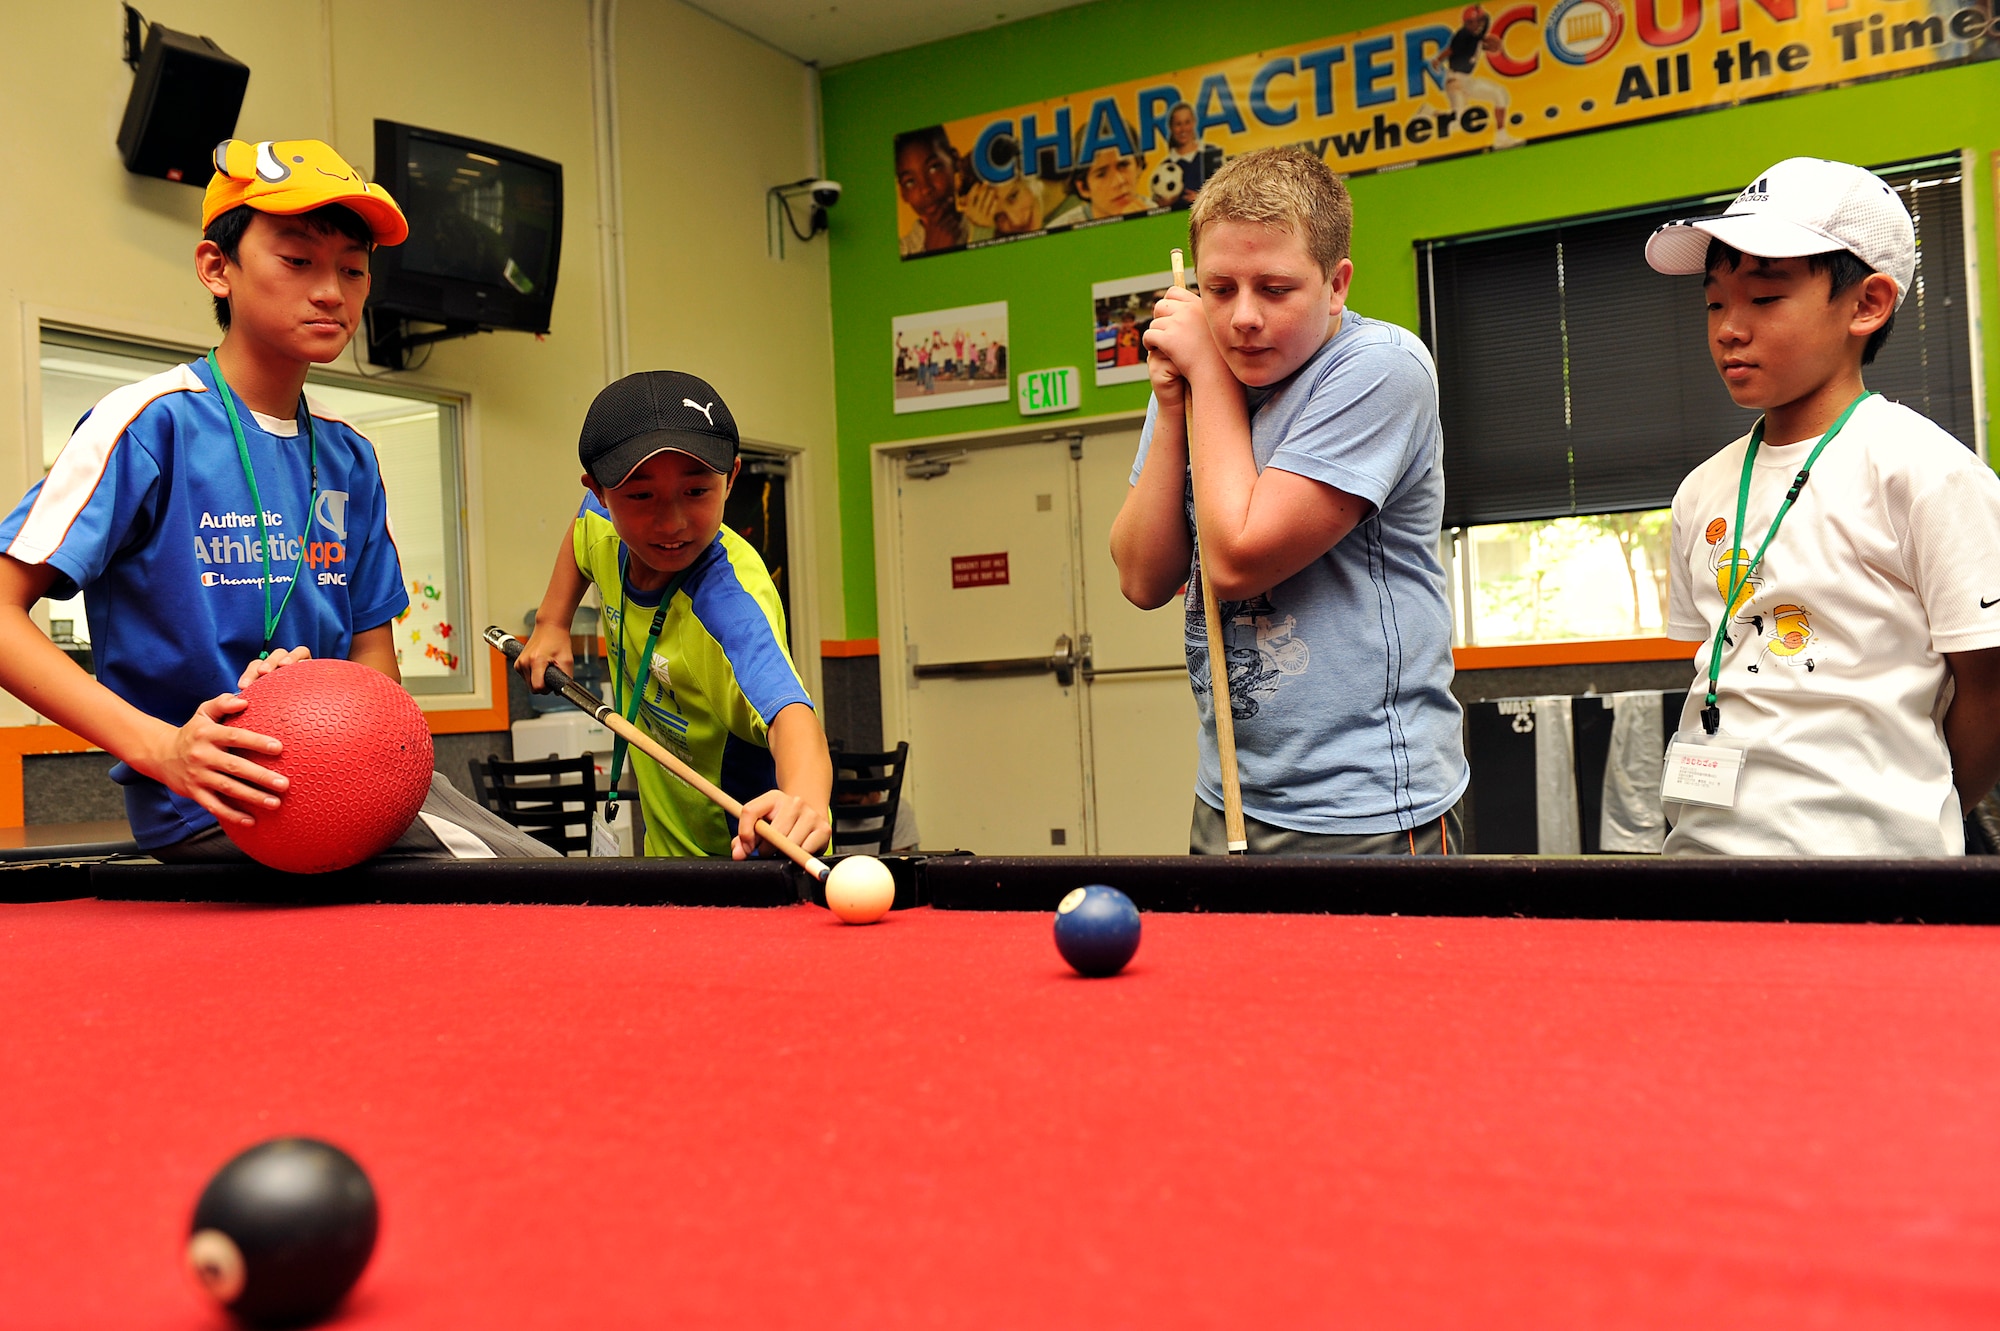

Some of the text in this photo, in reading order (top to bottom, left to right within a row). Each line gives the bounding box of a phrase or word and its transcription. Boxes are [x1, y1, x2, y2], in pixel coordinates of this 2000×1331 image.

[974, 0, 1905, 182] CHARACTER COUN
[1204, 105, 1489, 179] Eywhere
[1614, 49, 1692, 105] All
[1713, 41, 1810, 86] the
[1028, 370, 1068, 410] EXIT
[201, 572, 294, 590] Champion
